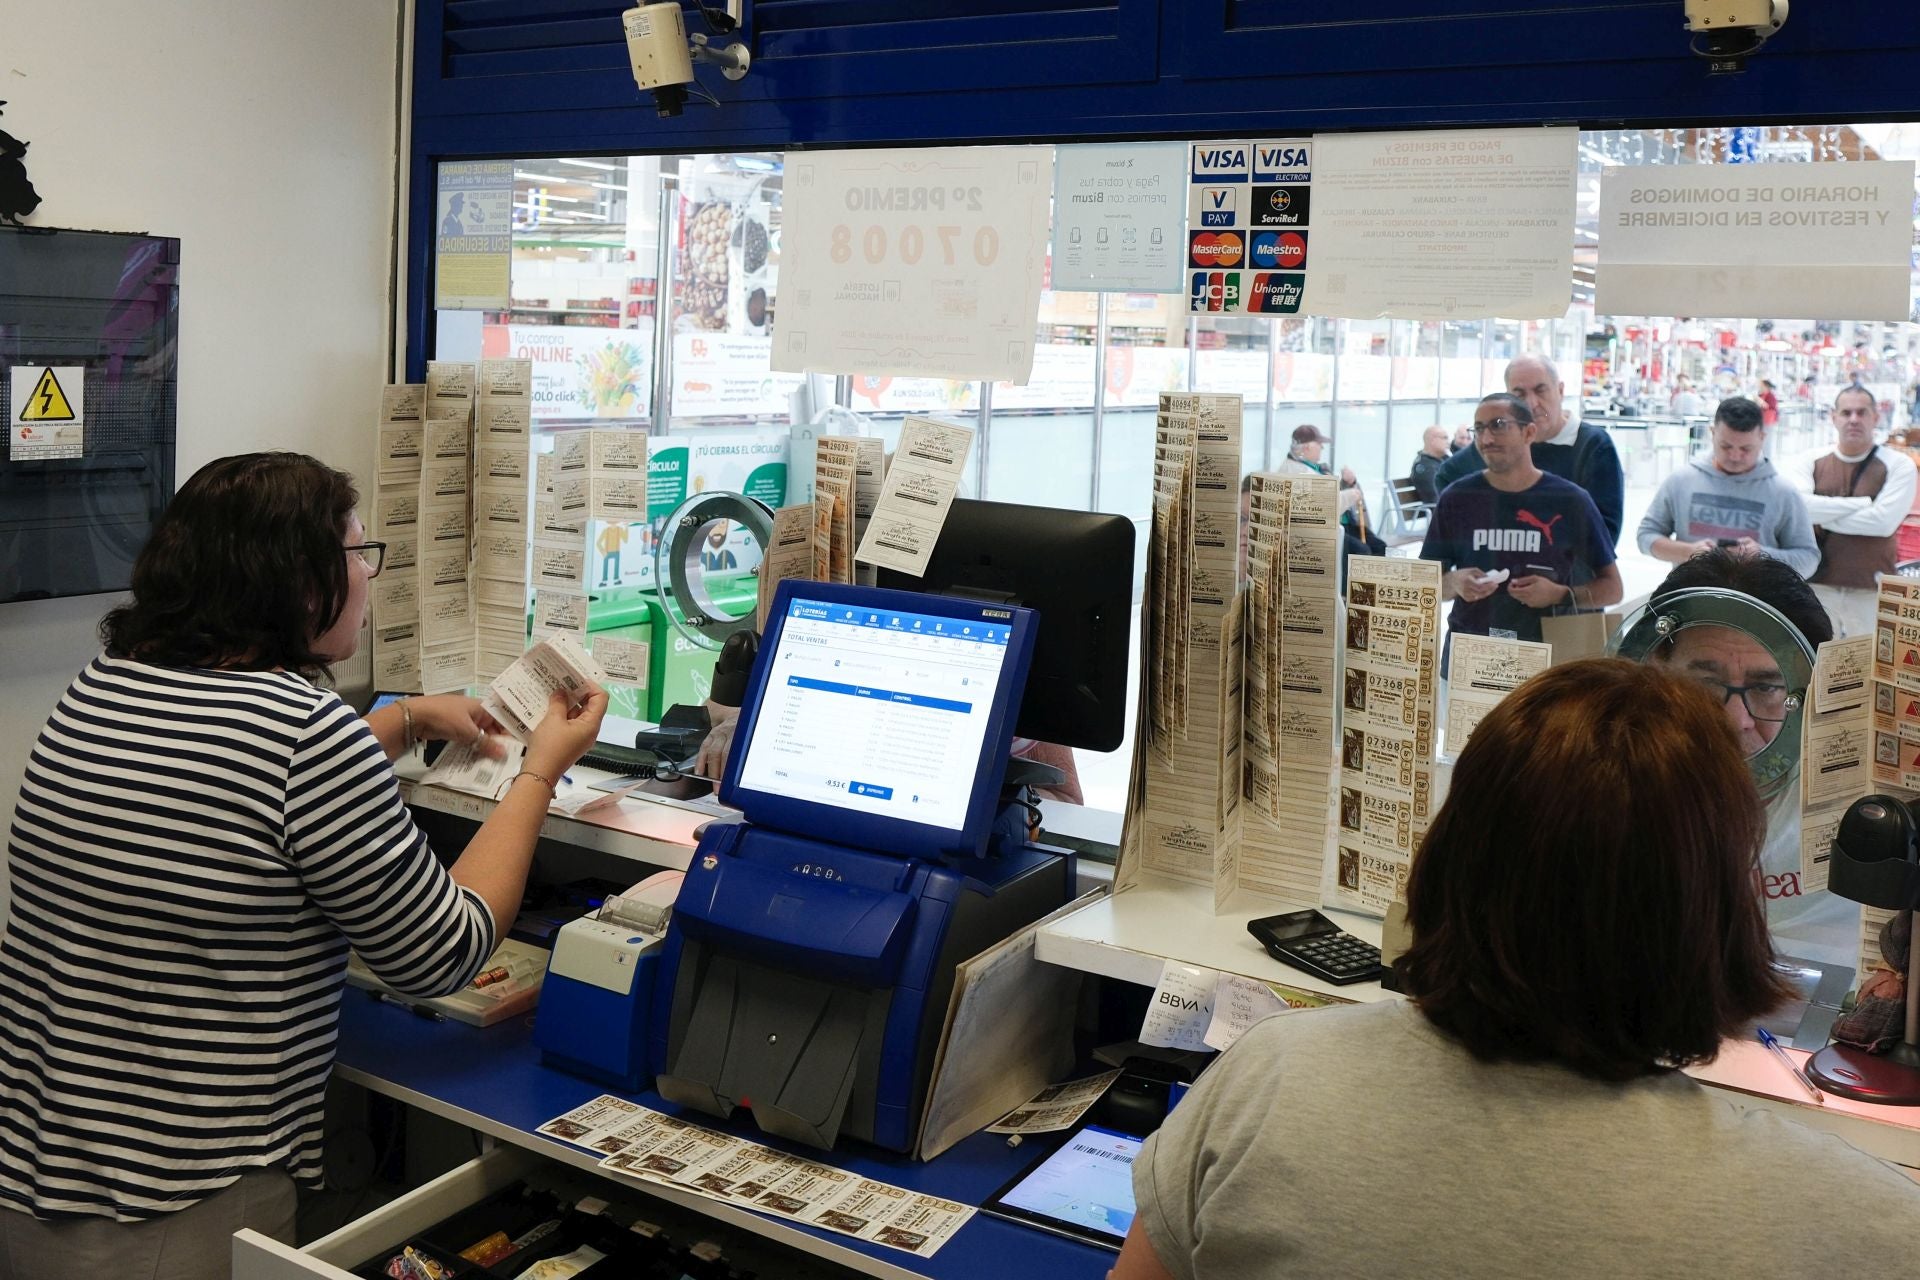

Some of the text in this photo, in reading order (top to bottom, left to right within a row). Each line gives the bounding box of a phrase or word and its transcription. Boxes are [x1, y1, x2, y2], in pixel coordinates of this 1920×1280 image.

[1197, 150, 1246, 168] VISA
[1258, 148, 1308, 167] VISA
[1210, 191, 1227, 208] V
[1208, 214, 1228, 224] PAY
[1262, 214, 1298, 223] ServiRed
[1192, 244, 1242, 255] MasterCard
[1256, 244, 1301, 255] Maestro
[1192, 285, 1238, 299] JCB
[1254, 283, 1302, 296] UnionPay
[514, 331, 564, 346] Tu compra
[518, 346, 573, 363] ONLINE
[555, 390, 576, 402] click
[710, 445, 740, 455] CIERRAS
[741, 446, 750, 454] EL
[751, 442, 782, 454] CÍRCULO!
[1473, 529, 1541, 553] PUMA
[1378, 588, 1418, 600] 65132
[802, 608, 828, 616] LOTERÍAS
[1372, 615, 1407, 628] 07368
[787, 634, 828, 644] TOTAL VENTAS
[1369, 674, 1403, 690] 07368
[1367, 736, 1400, 751] 07368
[1365, 796, 1397, 812] 07368
[1362, 856, 1395, 873] 07368
[1160, 992, 1198, 1012] BBVA
[659, 1135, 690, 1155] 48054
[836, 1190, 868, 1212] 07368
[895, 1204, 924, 1227] 48054
